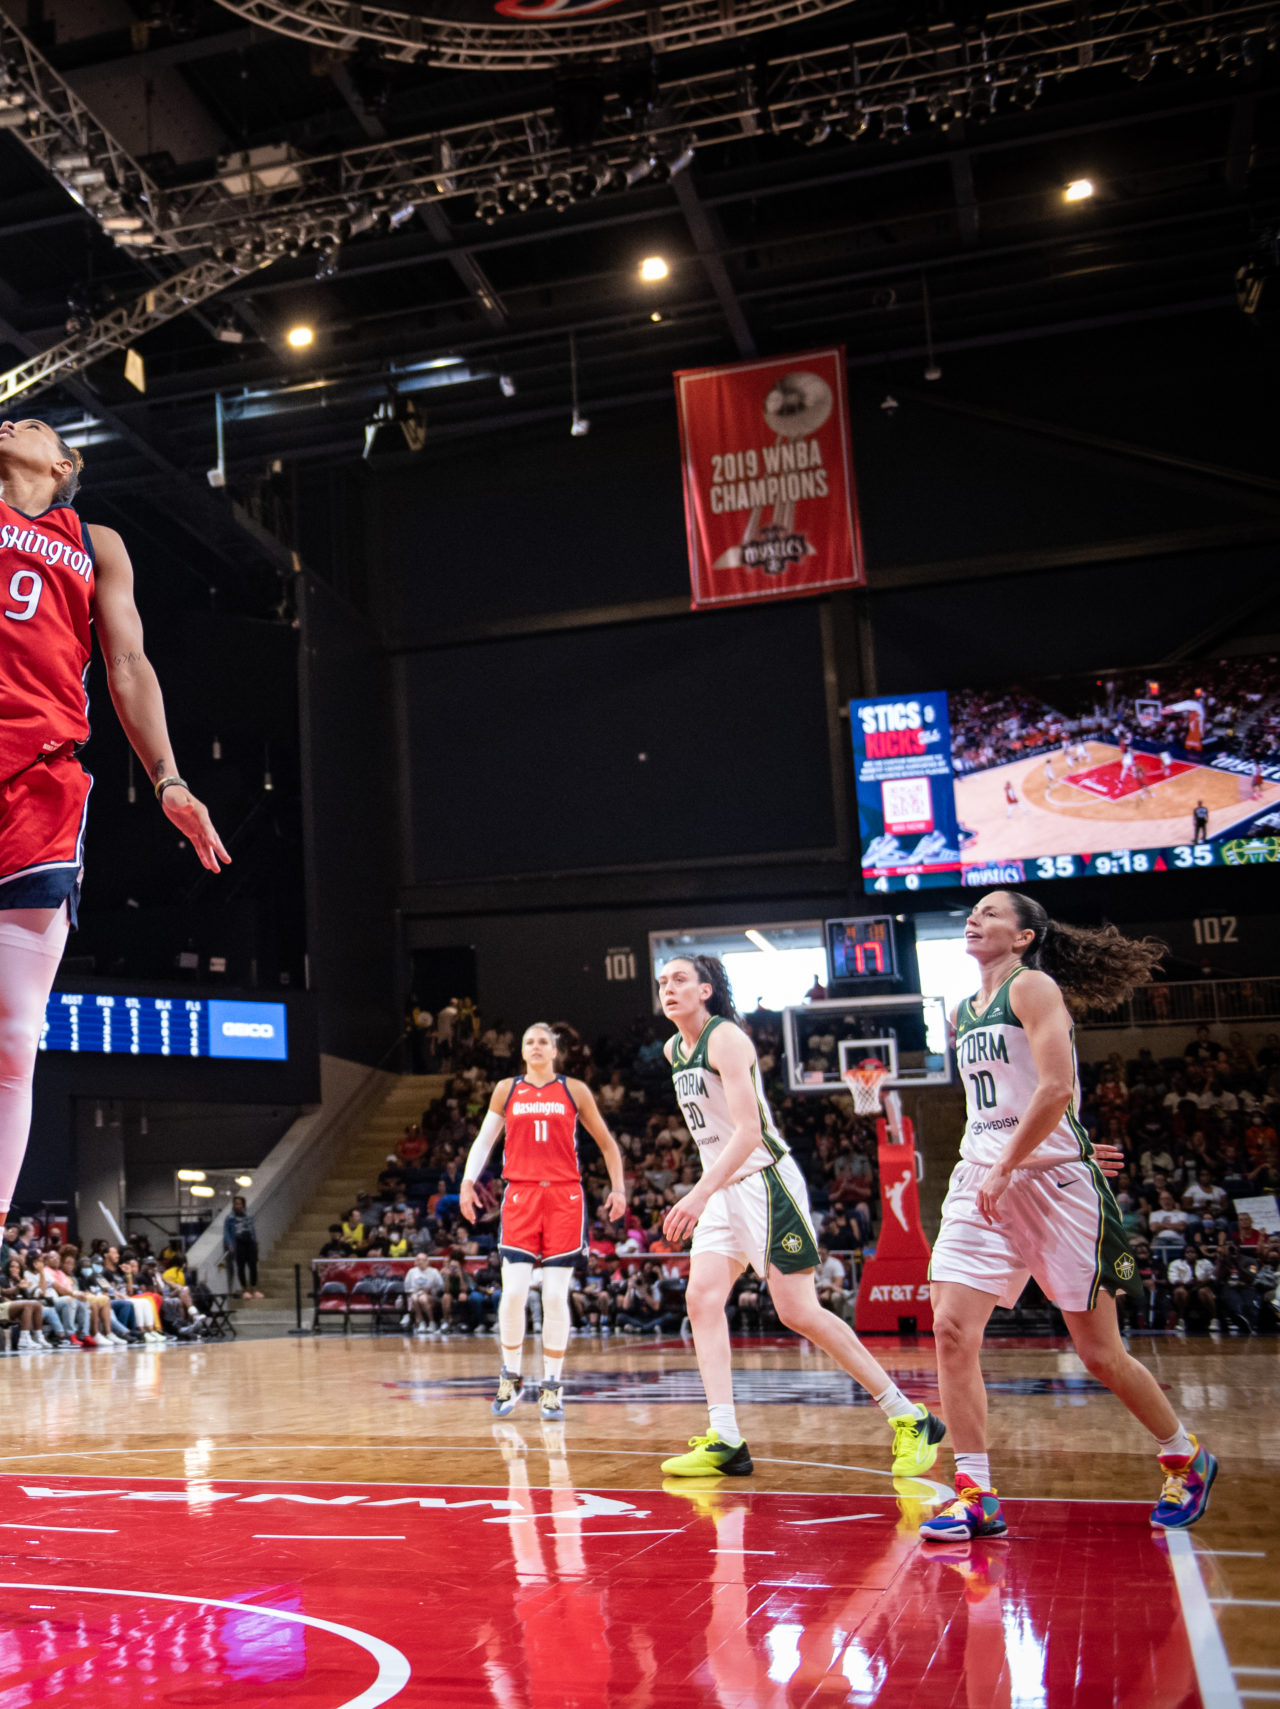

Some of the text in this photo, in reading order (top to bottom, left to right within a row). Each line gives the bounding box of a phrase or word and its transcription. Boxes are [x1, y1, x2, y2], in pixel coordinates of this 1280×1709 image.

[711, 439, 822, 484] 2019 WNBA
[709, 468, 829, 515] CHAMPIONS
[4, 570, 43, 621] 9
[1036, 855, 1075, 879] 35
[1095, 853, 1149, 876] 9:18
[1174, 844, 1213, 868] 35
[874, 873, 919, 892] 4 0
[1193, 916, 1239, 944] 102
[605, 953, 636, 980] 101
[855, 942, 884, 973] 17
[969, 1070, 997, 1110] 10
[683, 1101, 706, 1130] 30
[534, 1120, 548, 1142] 11
[869, 1285, 914, 1302] AT&T
[19, 1486, 524, 1510] WNBA
